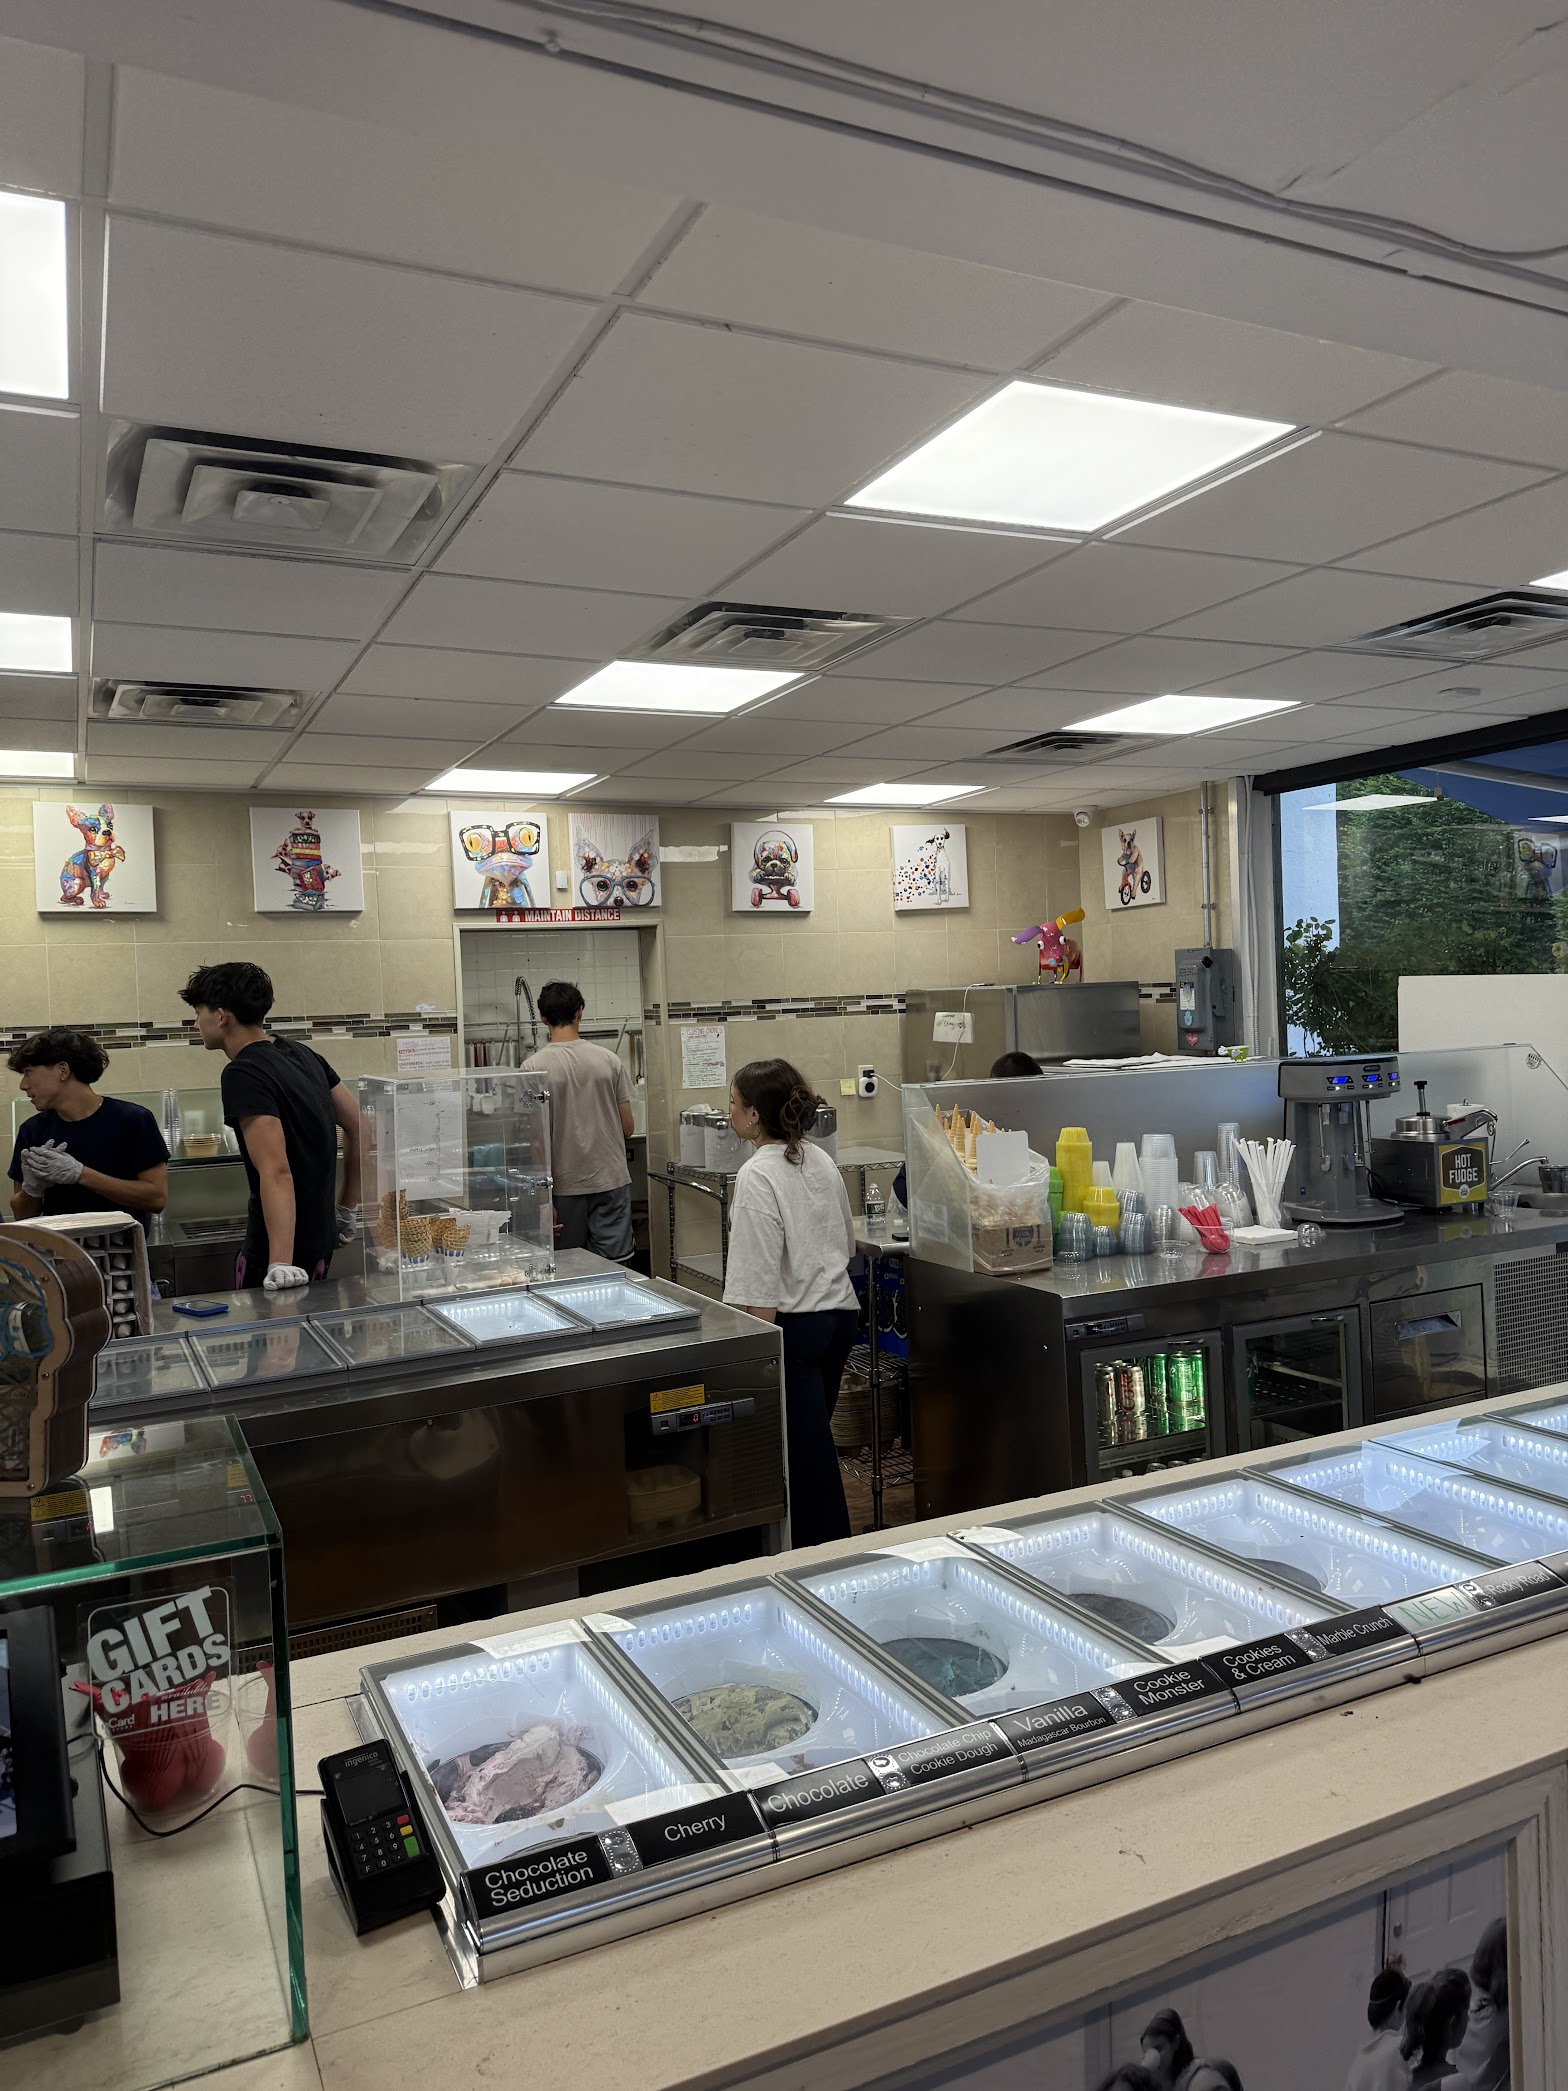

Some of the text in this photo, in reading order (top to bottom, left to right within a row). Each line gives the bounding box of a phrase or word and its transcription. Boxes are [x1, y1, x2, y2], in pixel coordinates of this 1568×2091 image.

[524, 909, 620, 922] MAINTAIN DISTANCE
[1454, 1153, 1472, 1169] HOT
[1449, 1167, 1479, 1184] FUDGE
[1485, 1570, 1550, 1595] Rocky Road
[1397, 1591, 1469, 1627] NEW
[87, 1585, 215, 1682] GIFT
[1316, 1617, 1393, 1646] Marble Crunch
[1223, 1645, 1282, 1667] Cookies
[1231, 1655, 1296, 1680] & Cream
[101, 1633, 231, 1714] CARDS
[1133, 1671, 1191, 1692] Cookie
[161, 1682, 209, 1700] available
[1138, 1679, 1205, 1705] Monster
[150, 1693, 221, 1724] HERE
[1013, 1705, 1088, 1732] Vanilla
[898, 1730, 991, 1762] Chocolate Chip
[1017, 1716, 1106, 1748] Madagascar Bourbon
[344, 1751, 379, 1768] ingenico
[910, 1742, 998, 1775] Cookie Dough
[767, 1774, 869, 1813] Chocolate
[664, 1814, 726, 1842] Cherry
[485, 1851, 588, 1888] Chocolate
[490, 1866, 594, 1907] Seduction
